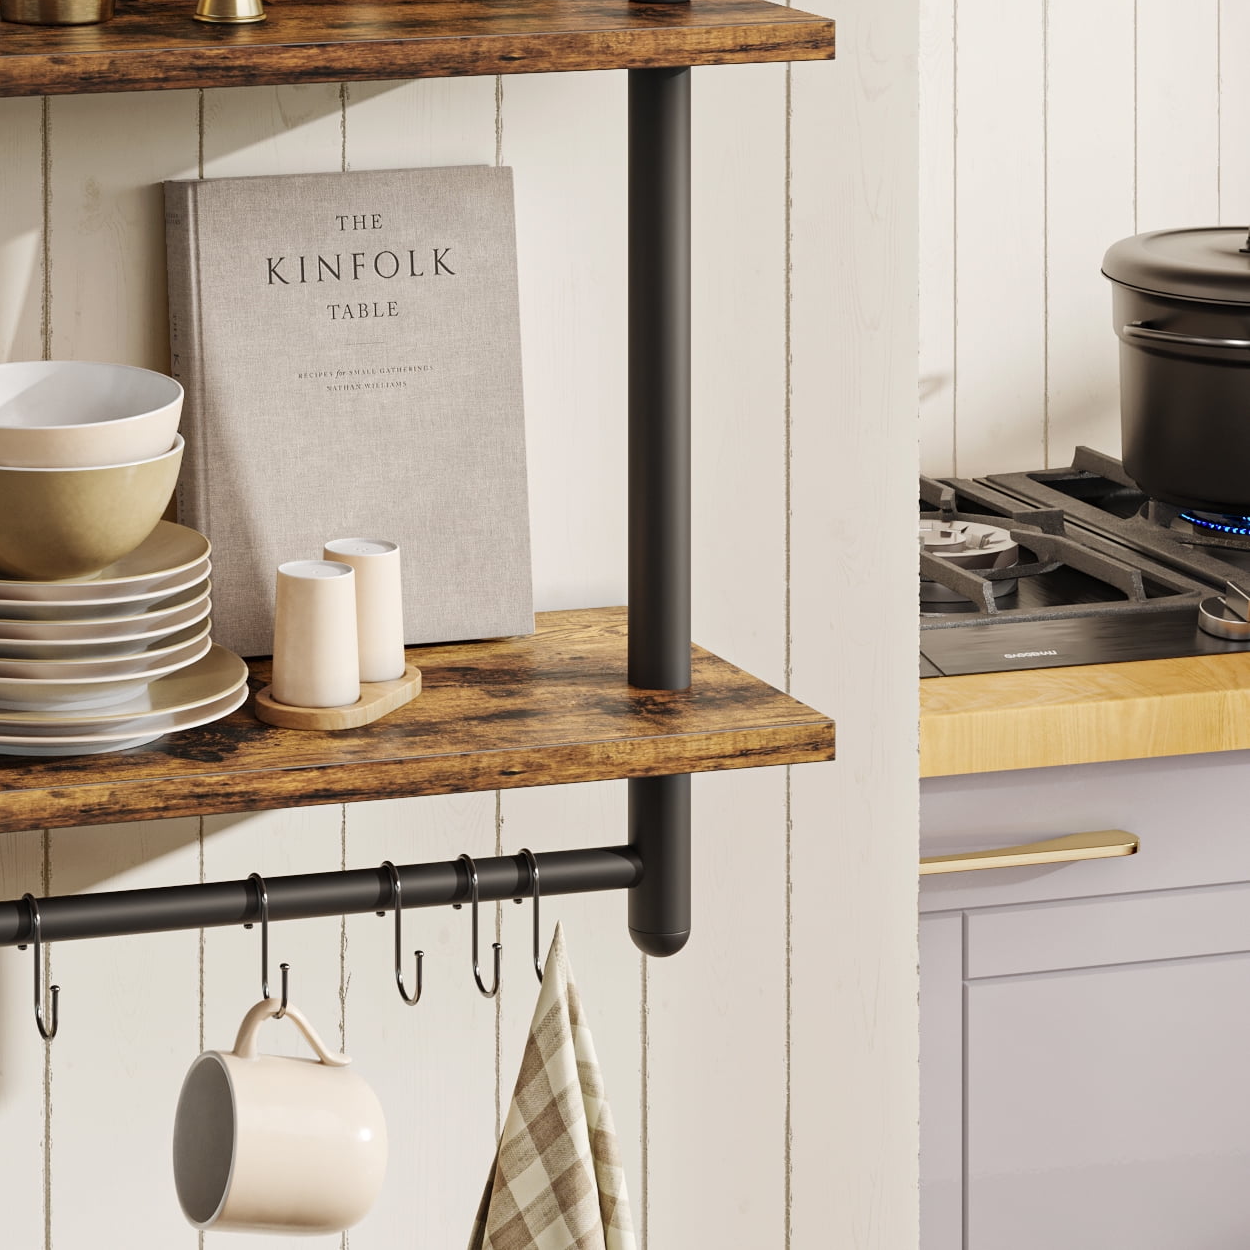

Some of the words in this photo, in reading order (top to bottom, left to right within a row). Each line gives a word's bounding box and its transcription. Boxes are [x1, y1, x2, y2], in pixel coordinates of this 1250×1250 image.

[335, 213, 384, 231] THE
[266, 247, 457, 285] KINFOLK
[326, 301, 400, 320] TABLE
